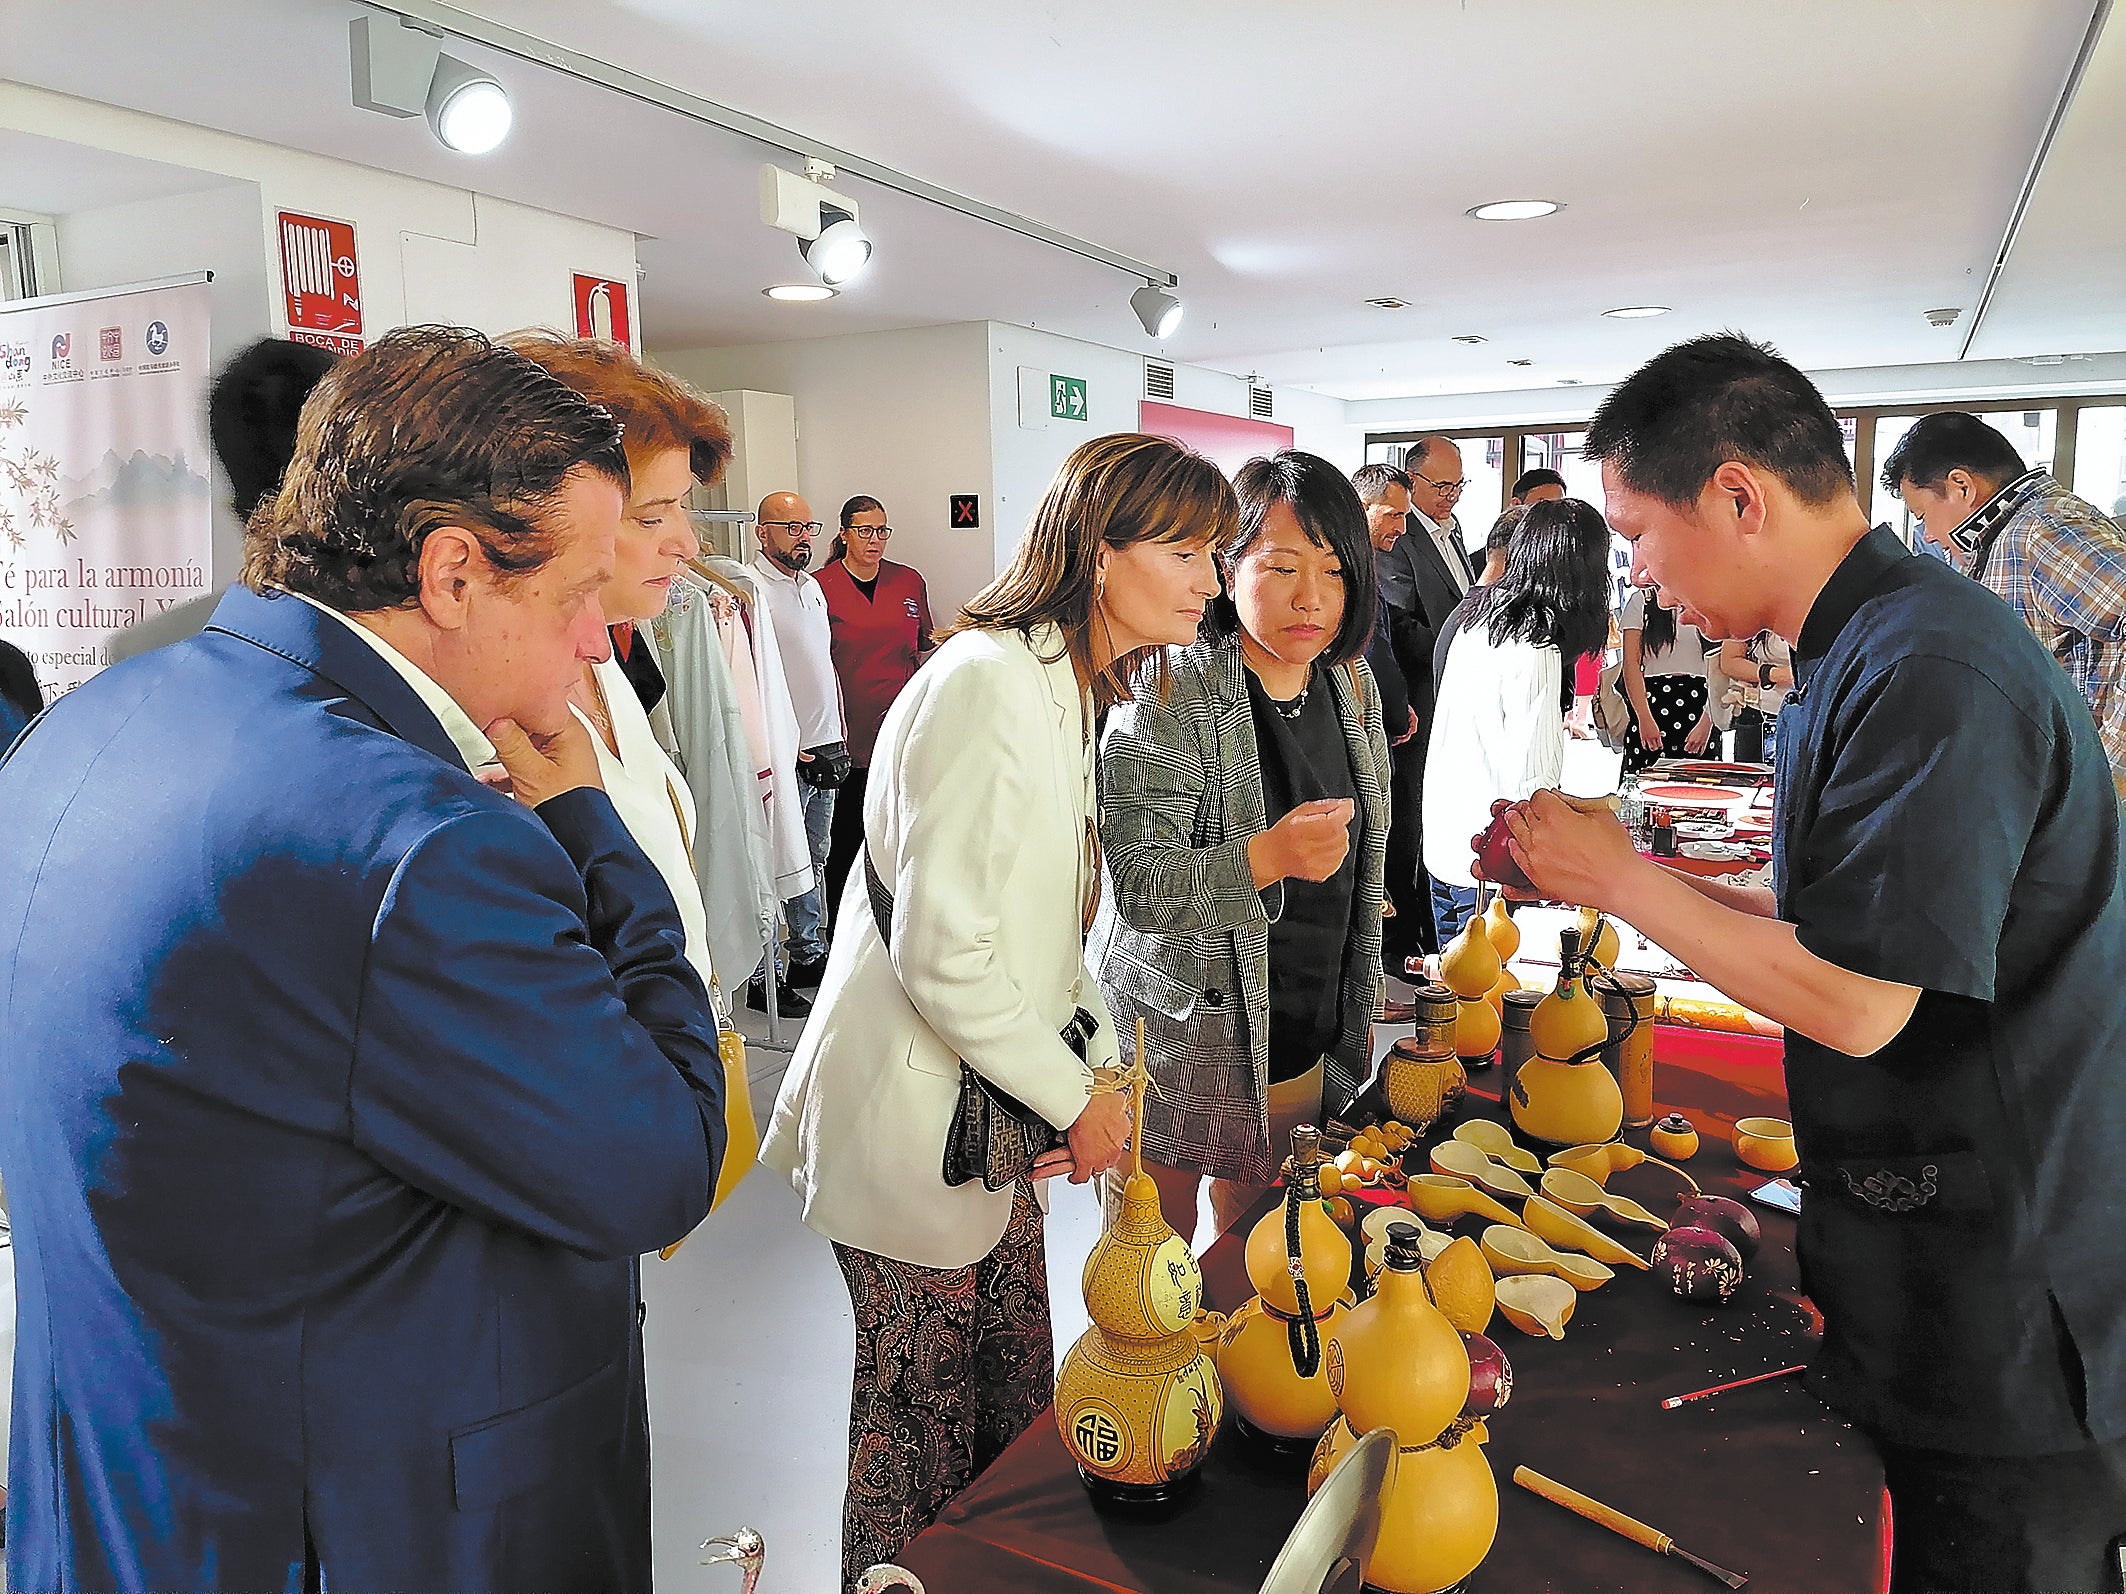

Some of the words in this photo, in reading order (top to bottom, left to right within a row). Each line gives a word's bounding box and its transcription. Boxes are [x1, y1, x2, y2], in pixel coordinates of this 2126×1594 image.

[295, 333, 335, 347] BOCA
[341, 338, 360, 349] DE
[52, 359, 71, 370] NICE
[0, 562, 16, 588] é
[25, 569, 69, 596] para
[78, 559, 98, 588] la
[105, 558, 204, 588] armonía
[56, 599, 146, 629] cultural
[42, 646, 96, 669] especial
[1075, 1414, 1119, 1462] 福
